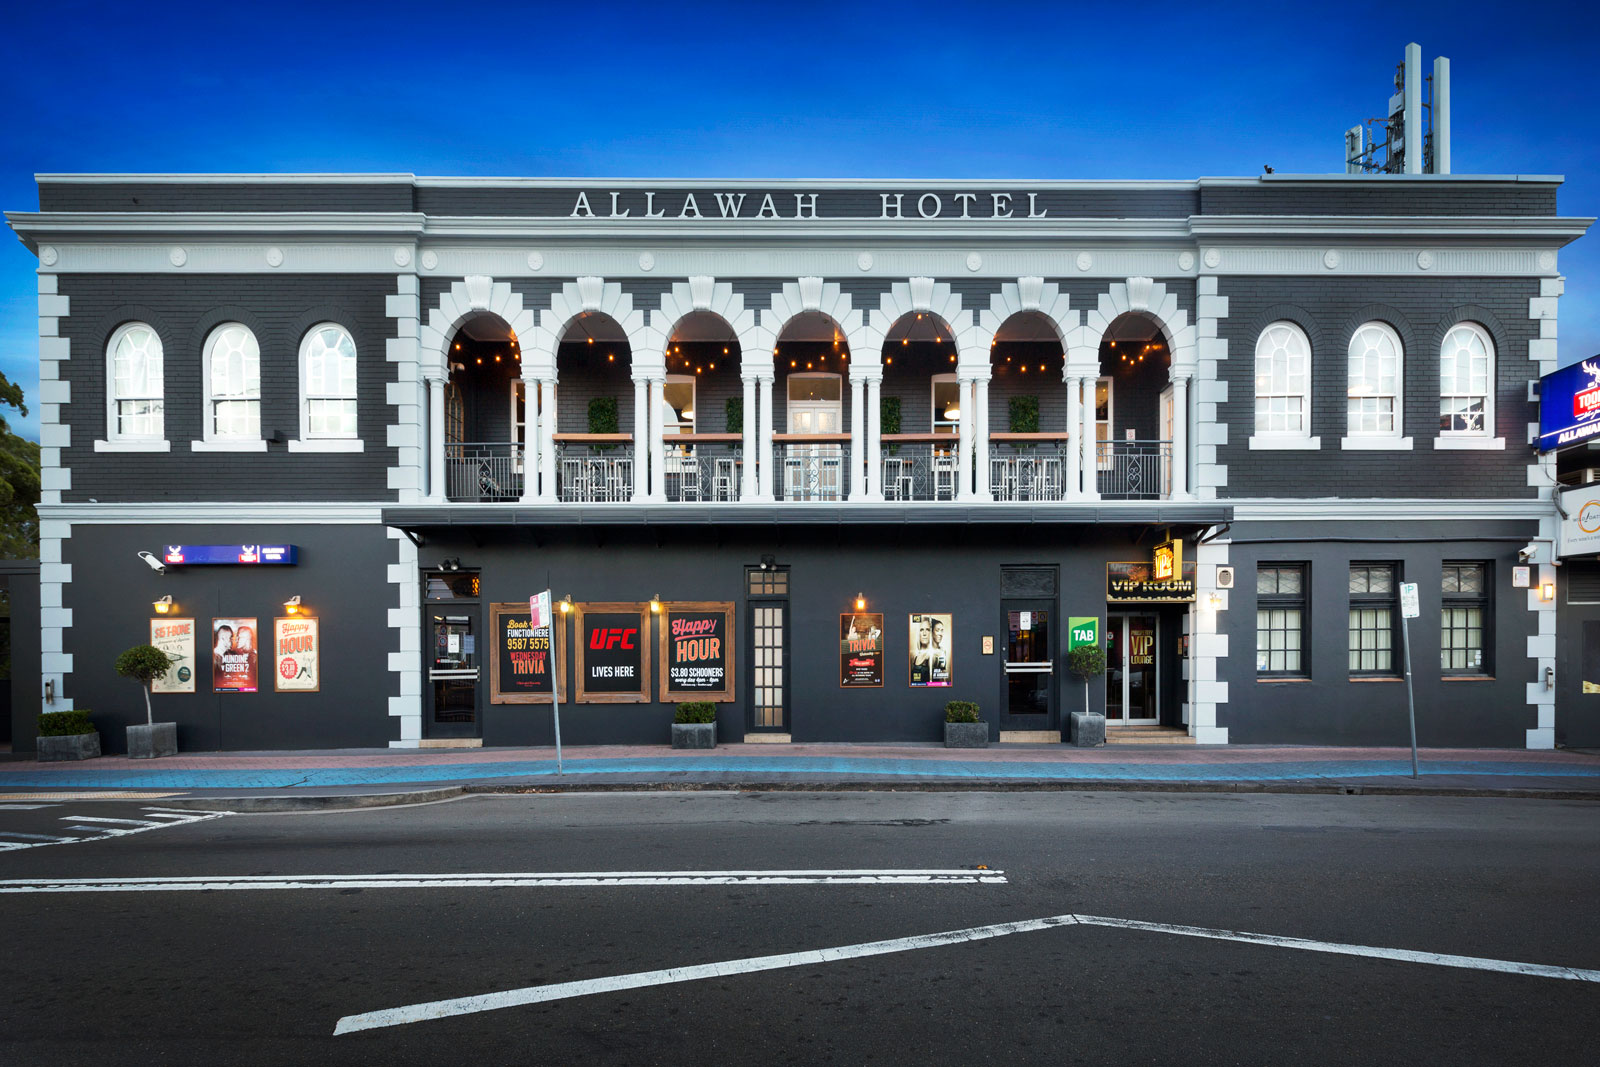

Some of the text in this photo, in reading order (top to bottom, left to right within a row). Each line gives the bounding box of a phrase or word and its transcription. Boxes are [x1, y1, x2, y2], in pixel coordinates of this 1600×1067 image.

[569, 191, 1048, 219] ALLAWAH HOTEL
[1112, 580, 1192, 592] VIP ROOM
[167, 623, 191, 637] T-BONE
[282, 623, 309, 634] Happy
[507, 619, 528, 629] Book
[672, 619, 717, 635] Happy
[507, 628, 549, 638] FUNCTION HERE
[590, 628, 637, 649] UFC
[1073, 629, 1094, 641] TAB
[280, 635, 313, 655] HOUR
[507, 638, 549, 650] 9587 5575
[848, 640, 876, 652] TRIVIA
[1131, 635, 1153, 655] VIP
[510, 651, 546, 660] WEDNESDAY
[676, 638, 720, 663] HOUR
[222, 654, 249, 664] MUNDINE
[1131, 655, 1153, 664] LOUNGE
[226, 663, 244, 672] GREEN
[245, 663, 249, 672] 2
[512, 660, 545, 674] TRIVIA
[592, 666, 634, 677] LIVES HERE
[671, 667, 723, 677] $3.80 SCHOONERS
